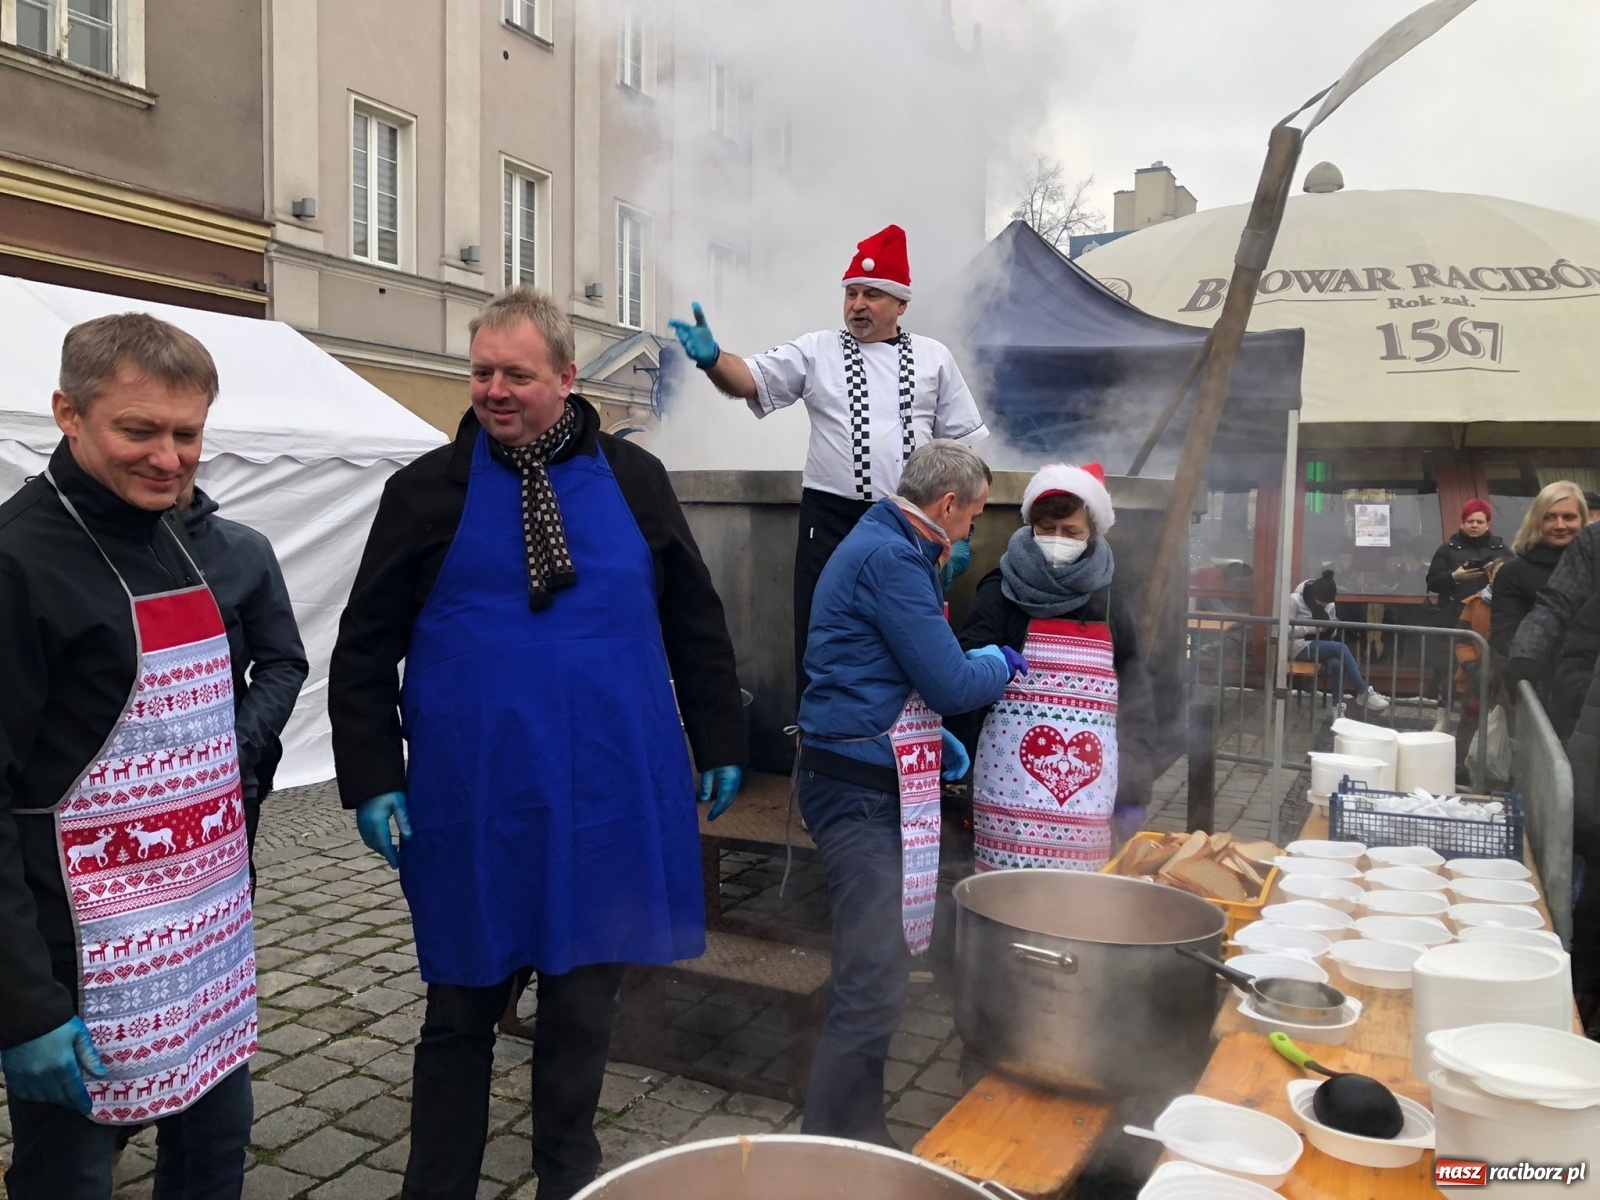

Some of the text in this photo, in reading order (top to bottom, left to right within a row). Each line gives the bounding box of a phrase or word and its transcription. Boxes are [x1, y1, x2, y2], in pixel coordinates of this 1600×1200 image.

[1178, 267, 1402, 312] BOWAR
[1388, 294, 1437, 309] Rok
[1376, 316, 1503, 364] 1567
